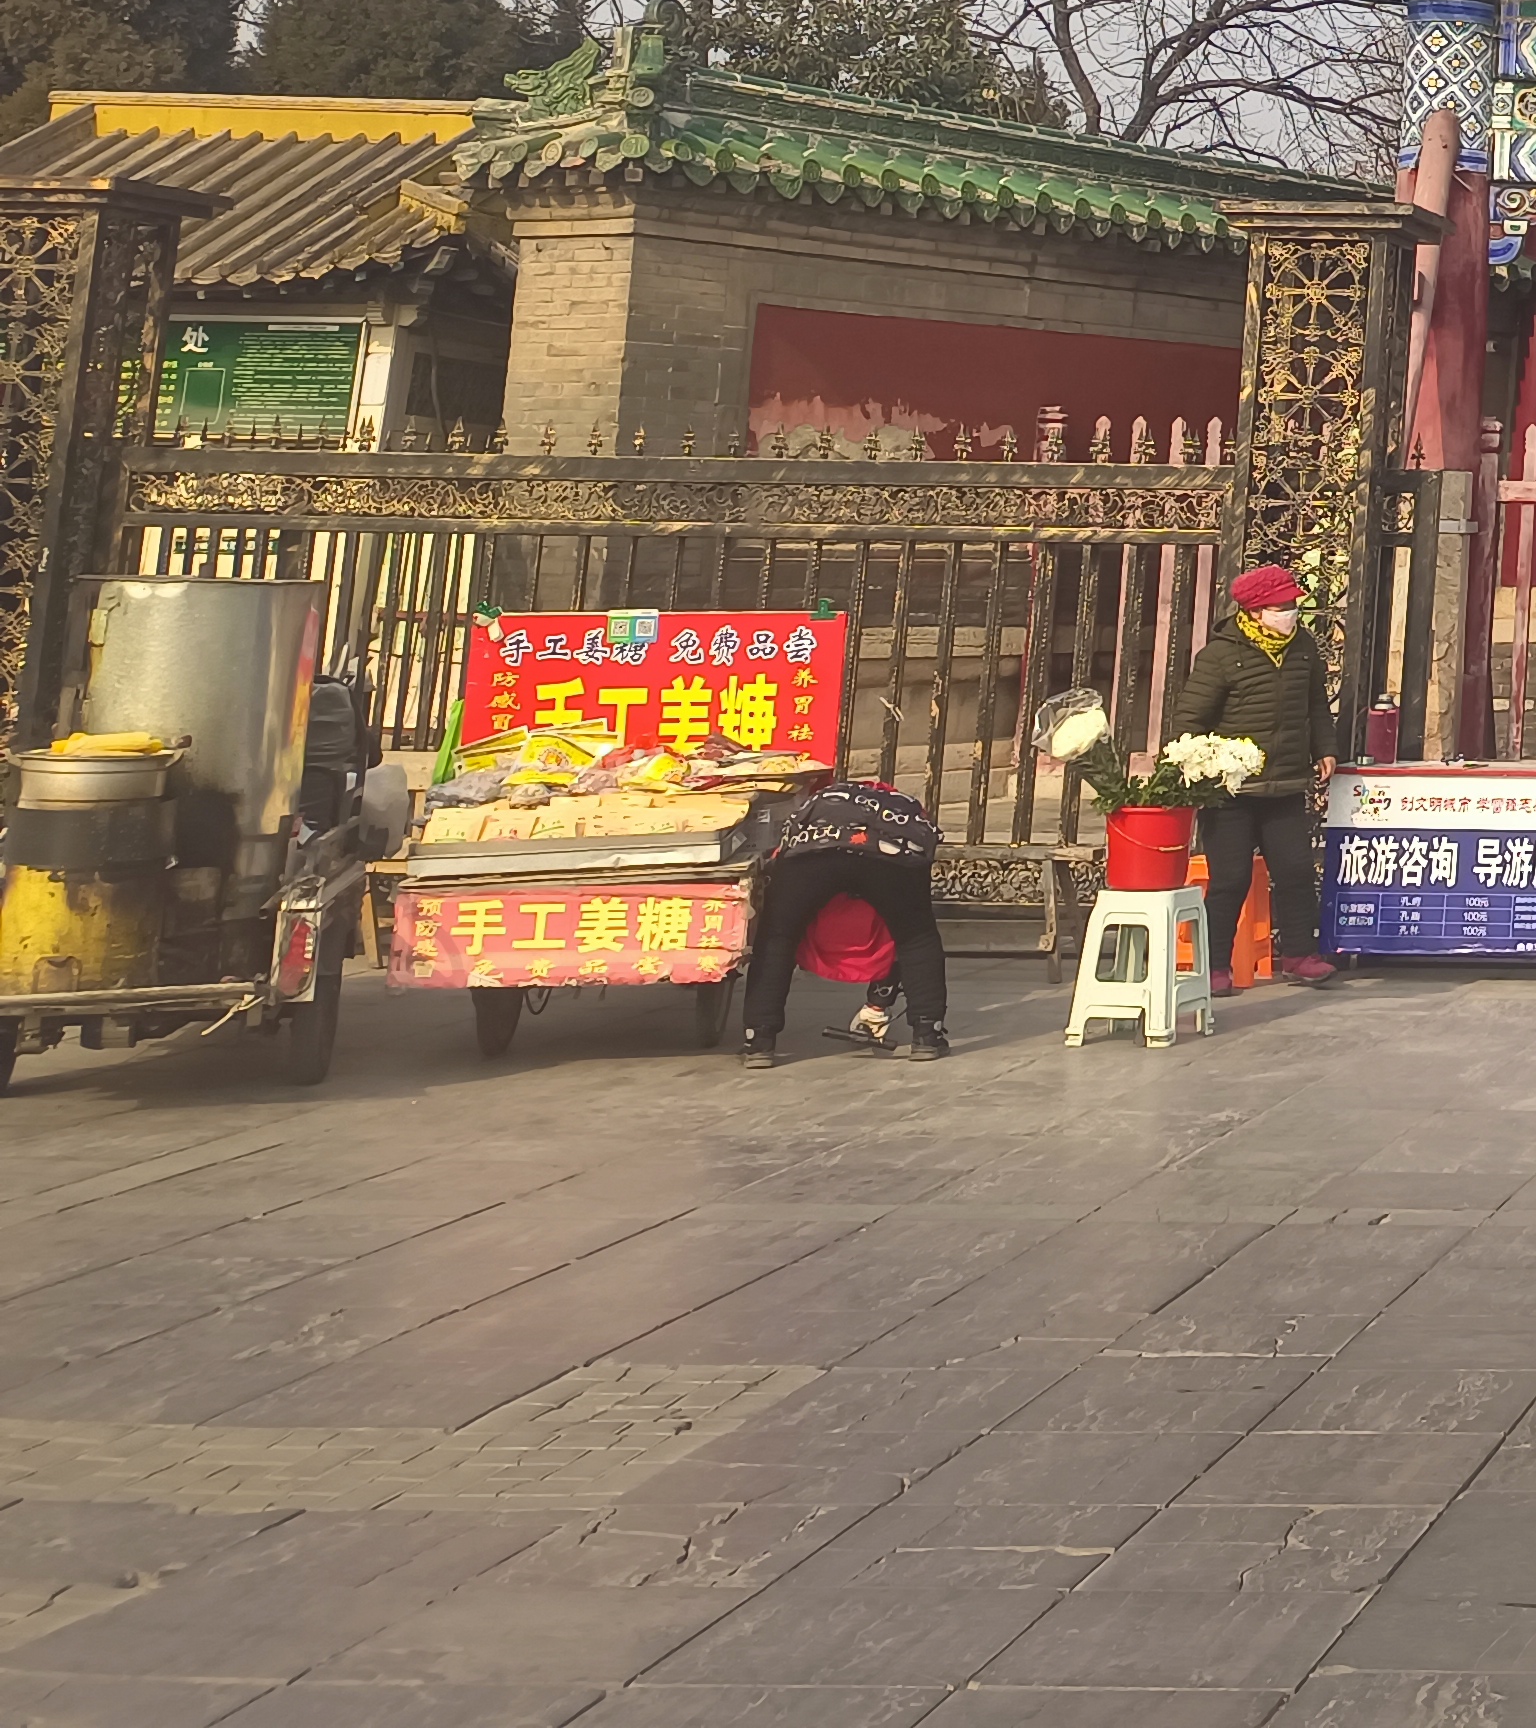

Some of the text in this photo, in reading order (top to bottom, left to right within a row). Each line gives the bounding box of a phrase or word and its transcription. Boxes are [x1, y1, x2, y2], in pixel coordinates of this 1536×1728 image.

[181, 326, 209, 353] 处
[668, 624, 818, 665] 免费品尝
[787, 669, 818, 764] 养胃祛
[1337, 835, 1458, 887] 旅游咨询
[450, 897, 693, 955] 手工姜糖
